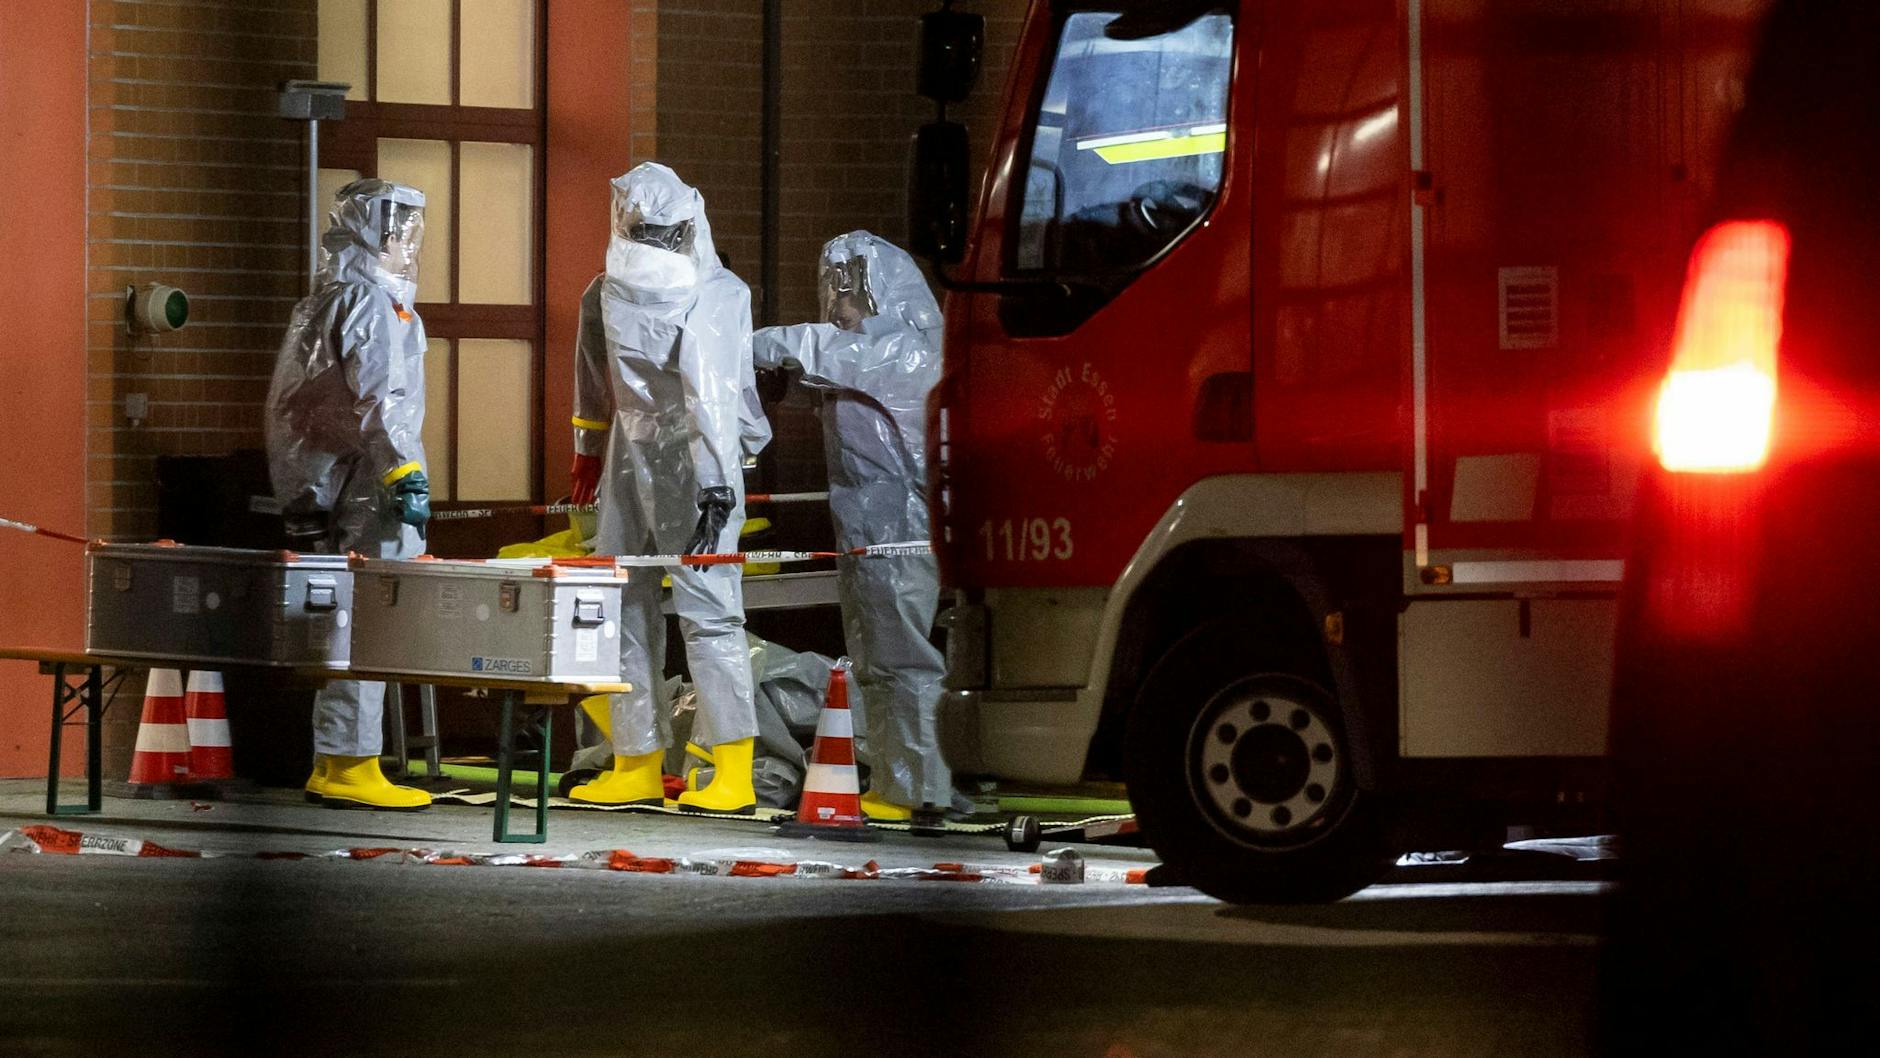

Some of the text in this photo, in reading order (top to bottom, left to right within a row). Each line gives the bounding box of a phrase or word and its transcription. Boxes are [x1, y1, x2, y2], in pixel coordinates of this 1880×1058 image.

[1039, 362, 1117, 421] Stadt Essen
[1040, 433, 1119, 481] Feuerwehr
[978, 517, 1074, 561] 11/93
[484, 658, 531, 673] ZARGES
[68, 834, 128, 852] SPERRZONE
